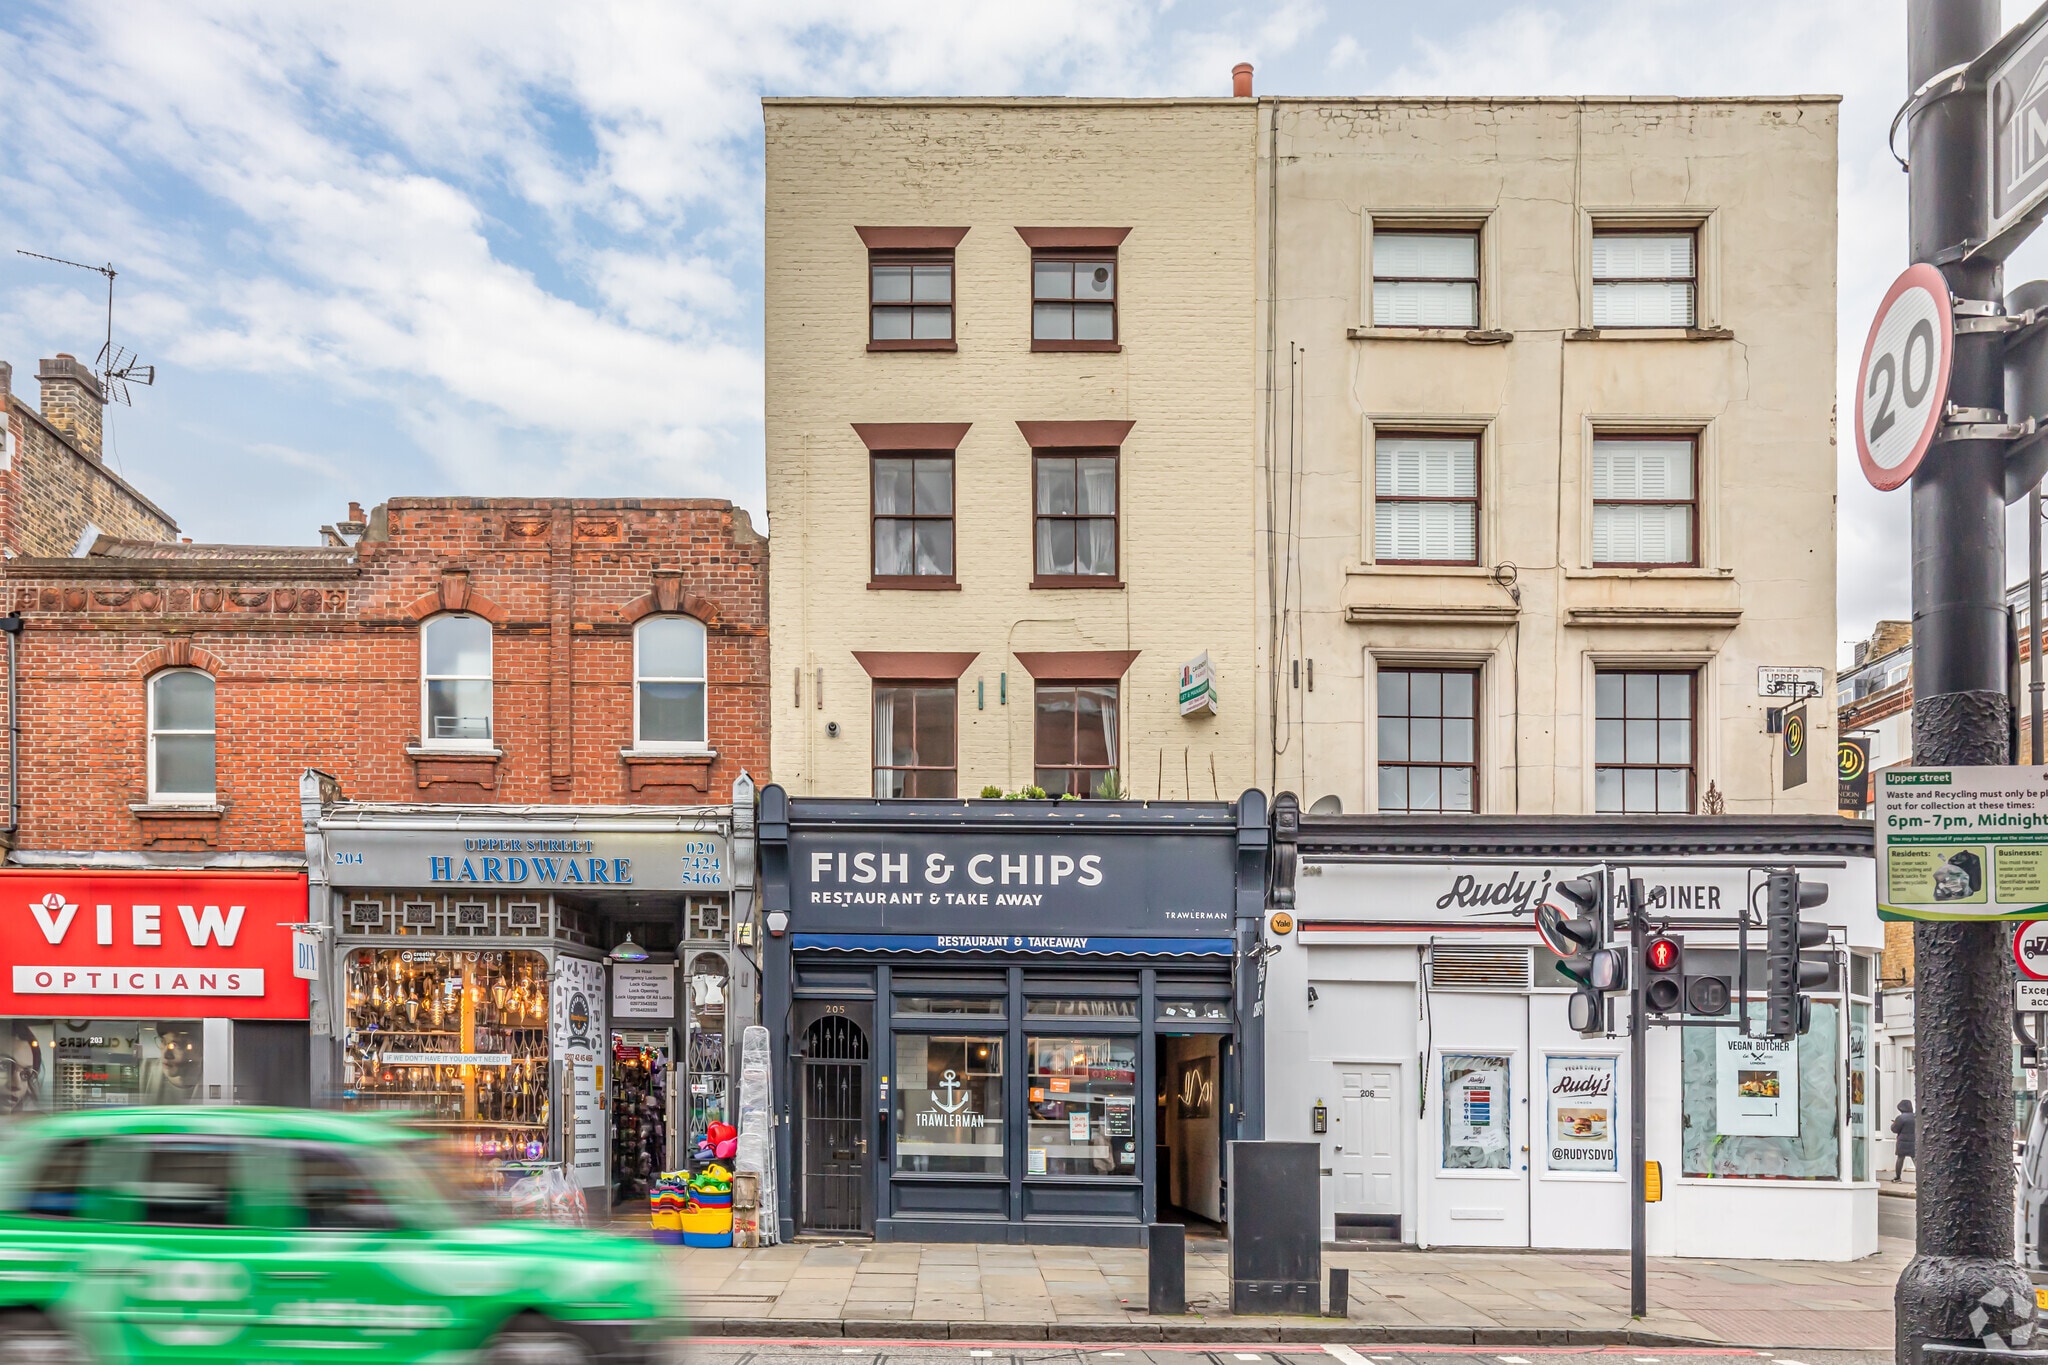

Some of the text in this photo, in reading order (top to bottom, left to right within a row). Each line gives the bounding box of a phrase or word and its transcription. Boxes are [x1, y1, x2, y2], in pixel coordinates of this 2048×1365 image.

[1869, 318, 1934, 444] 20
[1767, 673, 1799, 683] UPPER
[1767, 684, 1806, 694] SREET
[1887, 773, 1950, 784] Upper street
[1935, 790, 1978, 800] Recycling
[1980, 790, 2001, 798] must
[2004, 790, 2024, 799] only
[2026, 789, 2038, 797] be
[1887, 802, 1902, 810] out
[1904, 802, 1918, 810] for
[1921, 802, 1965, 810] collection
[1979, 801, 2004, 809] these
[2006, 801, 2035, 809] times:
[1978, 813, 2048, 829] Midnight
[465, 838, 595, 853] UPPER STREET
[686, 842, 715, 855] 020
[336, 853, 363, 865] 204
[681, 857, 720, 870] 7424
[429, 856, 633, 884] HARDWARE
[811, 852, 1104, 886] FISH & CHIPS
[681, 872, 721, 884] 5466
[811, 891, 1043, 906] RESTAURANT & TAKE AWAY
[1436, 869, 1552, 917] Rudy's
[1655, 885, 1721, 909] DINER
[48, 893, 58, 907] A
[1165, 911, 1227, 920] TRAWLERMAN
[29, 904, 245, 947] VIEW
[937, 936, 1088, 949] RESTAURANT & TAKEAWAY
[36, 971, 240, 991] OPTICIANS
[826, 1005, 845, 1014] 205
[1728, 1041, 1790, 1051] VEGAN BUTCHER
[1552, 1073, 1611, 1097] Rudy's
[1360, 1090, 1375, 1098] 206
[916, 1113, 984, 1128] TRAWLERMAN
[1552, 1147, 1614, 1161] @RUDYSDVD
